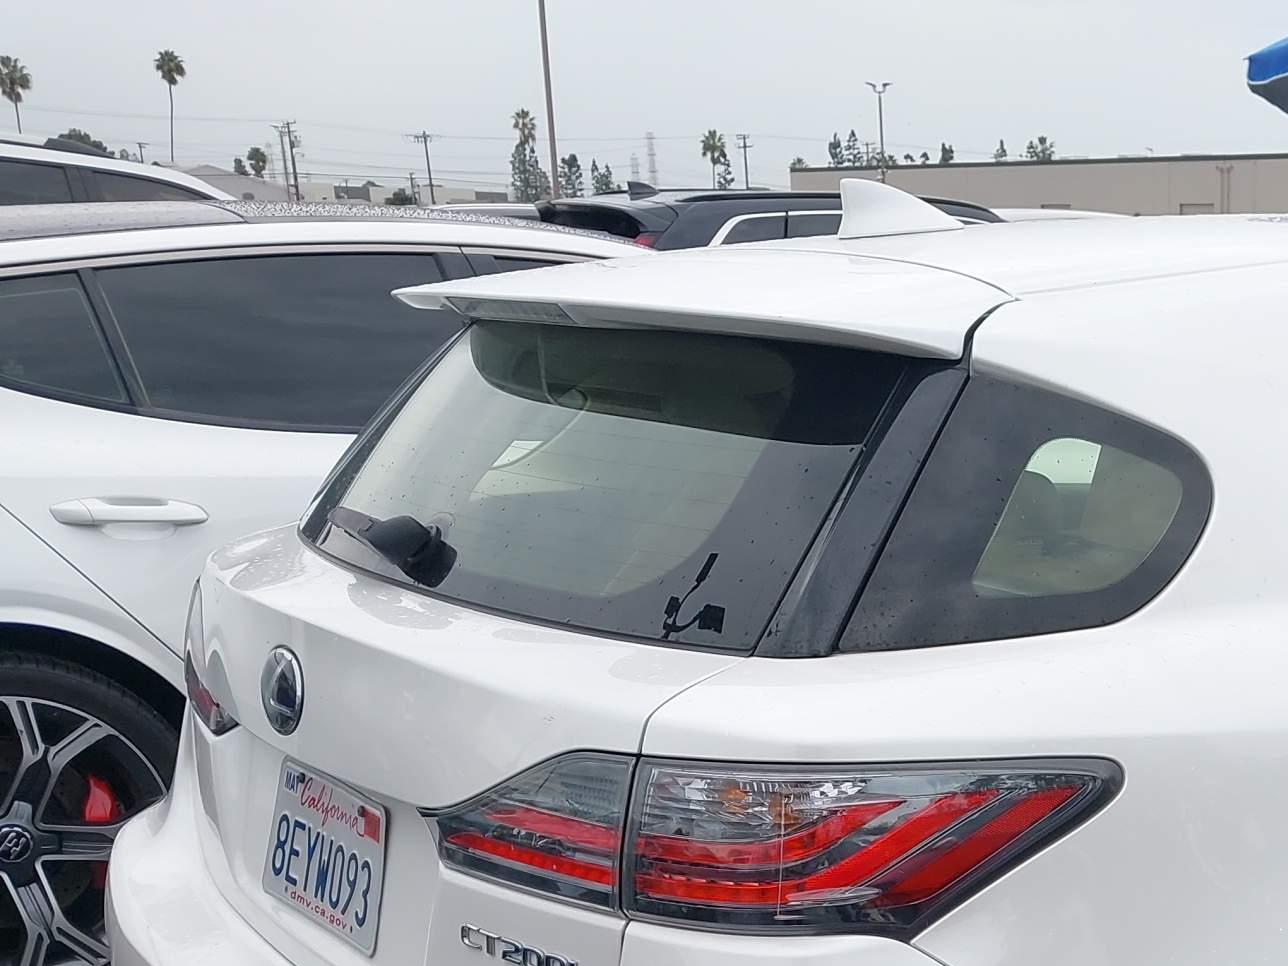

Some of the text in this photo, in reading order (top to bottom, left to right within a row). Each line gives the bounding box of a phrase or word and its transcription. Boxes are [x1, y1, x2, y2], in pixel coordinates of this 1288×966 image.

[300, 776, 365, 838] California
[271, 812, 372, 928] 8EYW093
[289, 888, 348, 930] dmv.ca.gov
